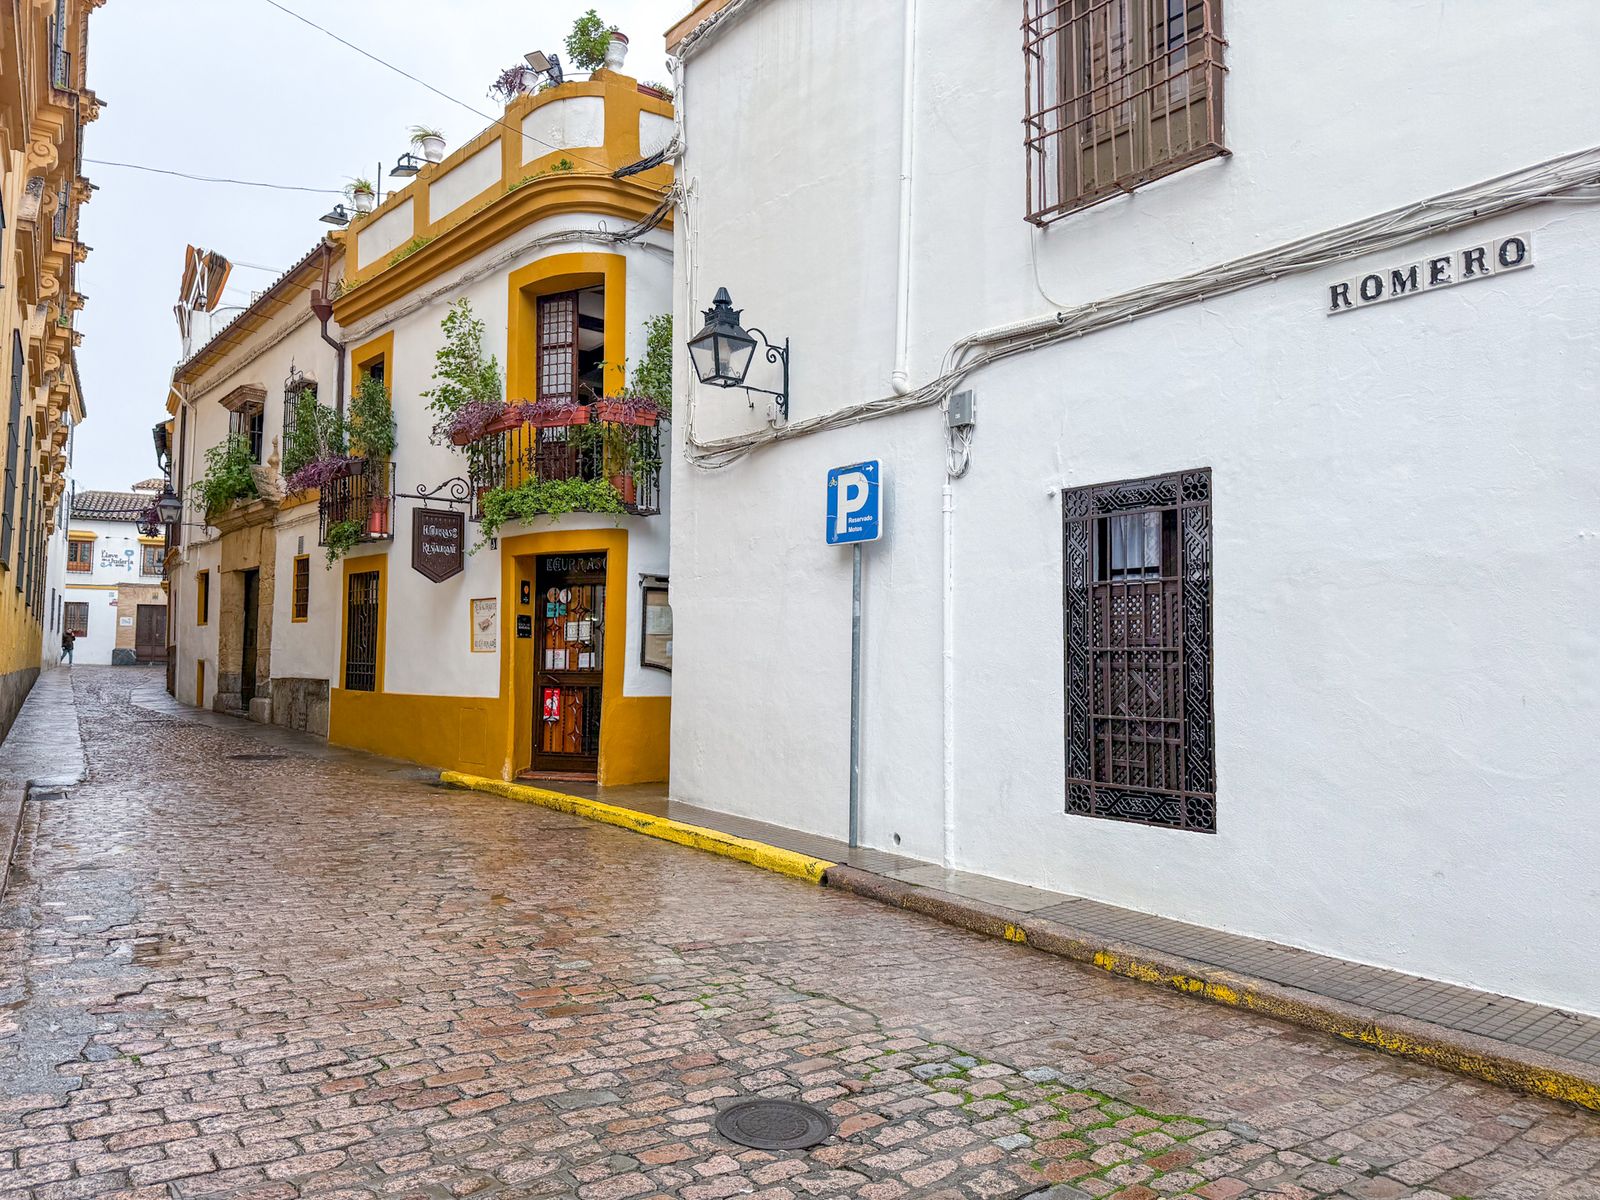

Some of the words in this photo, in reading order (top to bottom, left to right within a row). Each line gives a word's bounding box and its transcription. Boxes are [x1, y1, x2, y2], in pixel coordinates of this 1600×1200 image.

[1329, 237, 1528, 311] ROMERO
[836, 472, 869, 534] P
[848, 515, 873, 523] Reservado
